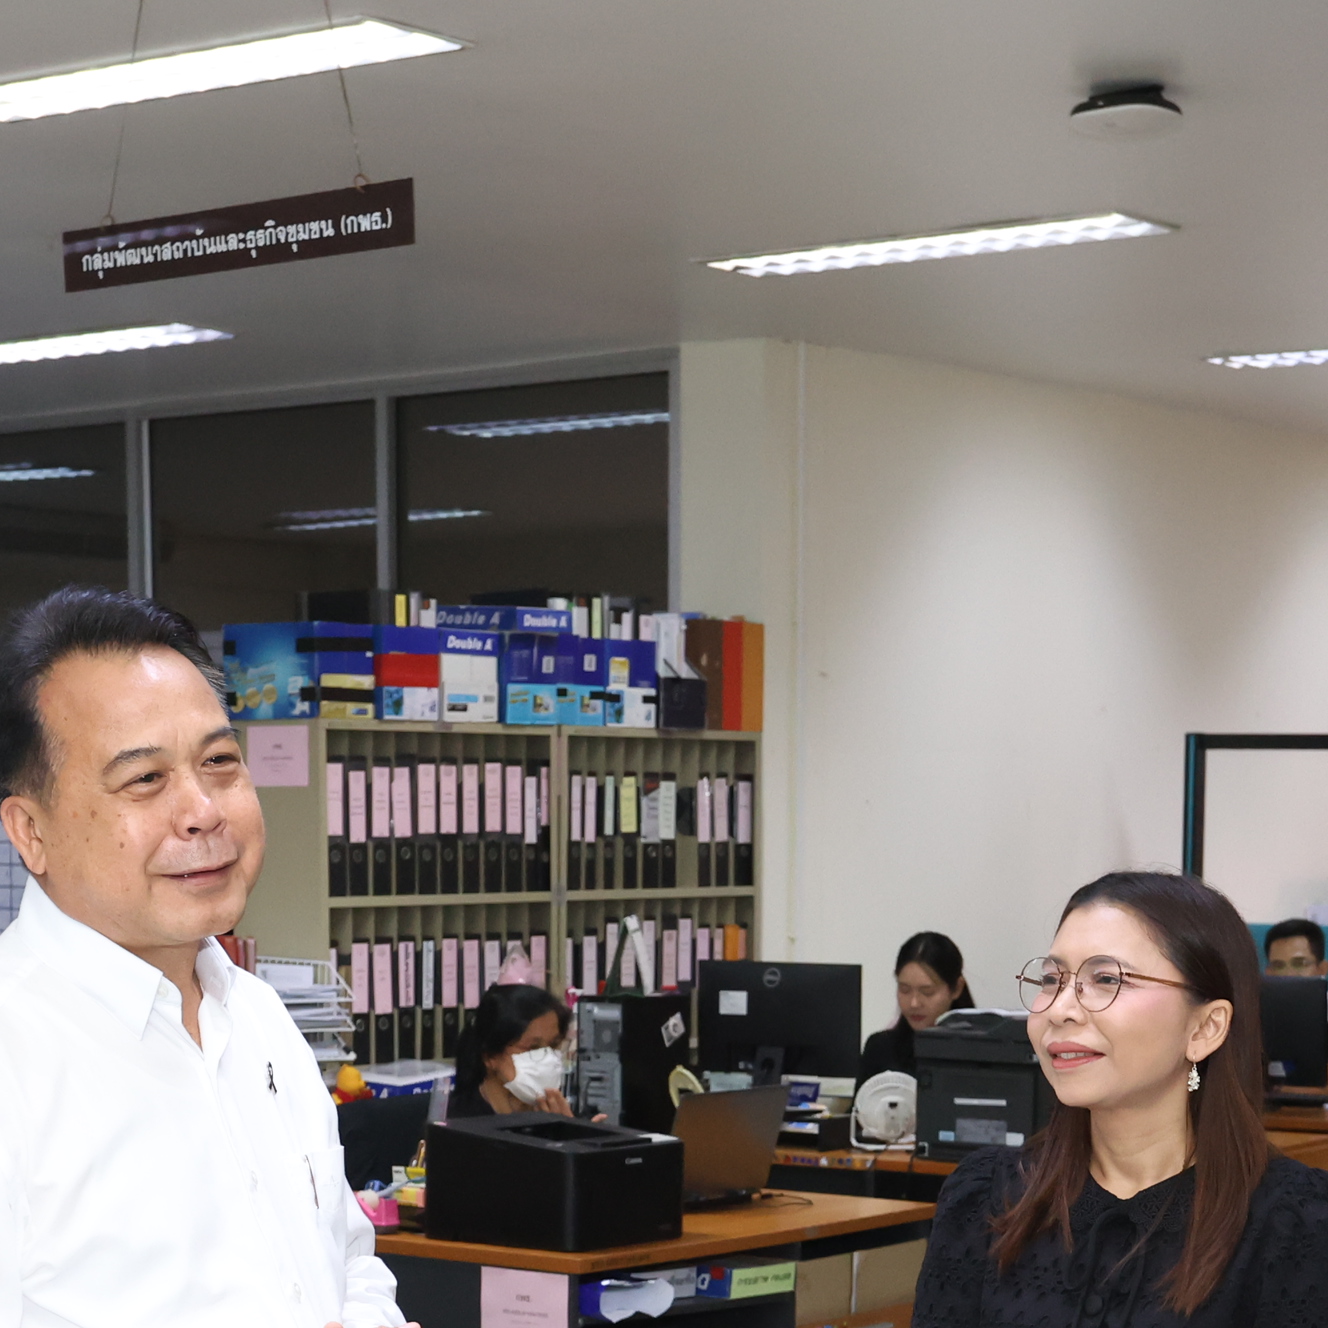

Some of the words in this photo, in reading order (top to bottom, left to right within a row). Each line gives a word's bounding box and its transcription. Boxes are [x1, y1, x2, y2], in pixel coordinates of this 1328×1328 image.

[340, 207, 392, 236] (กพธ.)
[436, 611, 487, 626] Double
[489, 611, 501, 625] A
[523, 613, 557, 628] Double
[559, 615, 568, 628] A
[446, 635, 483, 651] Double
[483, 637, 493, 651] A
